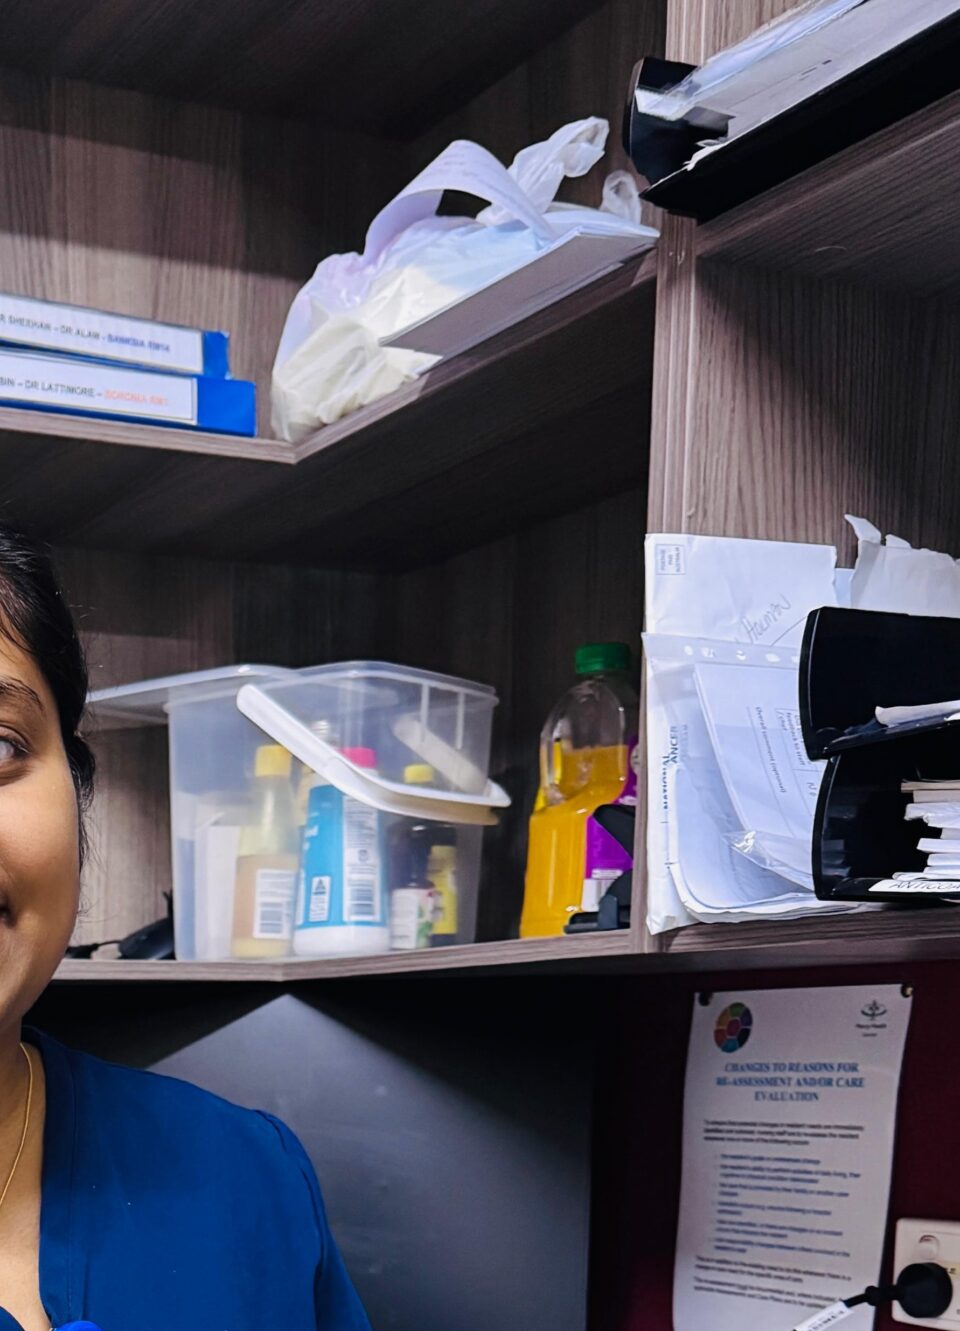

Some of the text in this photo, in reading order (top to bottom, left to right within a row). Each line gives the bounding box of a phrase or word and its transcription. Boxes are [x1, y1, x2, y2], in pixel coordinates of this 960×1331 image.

[670, 725, 678, 764] ANCER
[725, 1063, 859, 1073] CHANGES TO REASONS FOR
[716, 1077, 793, 1087] RE-ASSESSMENT
[836, 1077, 865, 1088] CARE
[754, 1091, 819, 1101] EVALUATION
